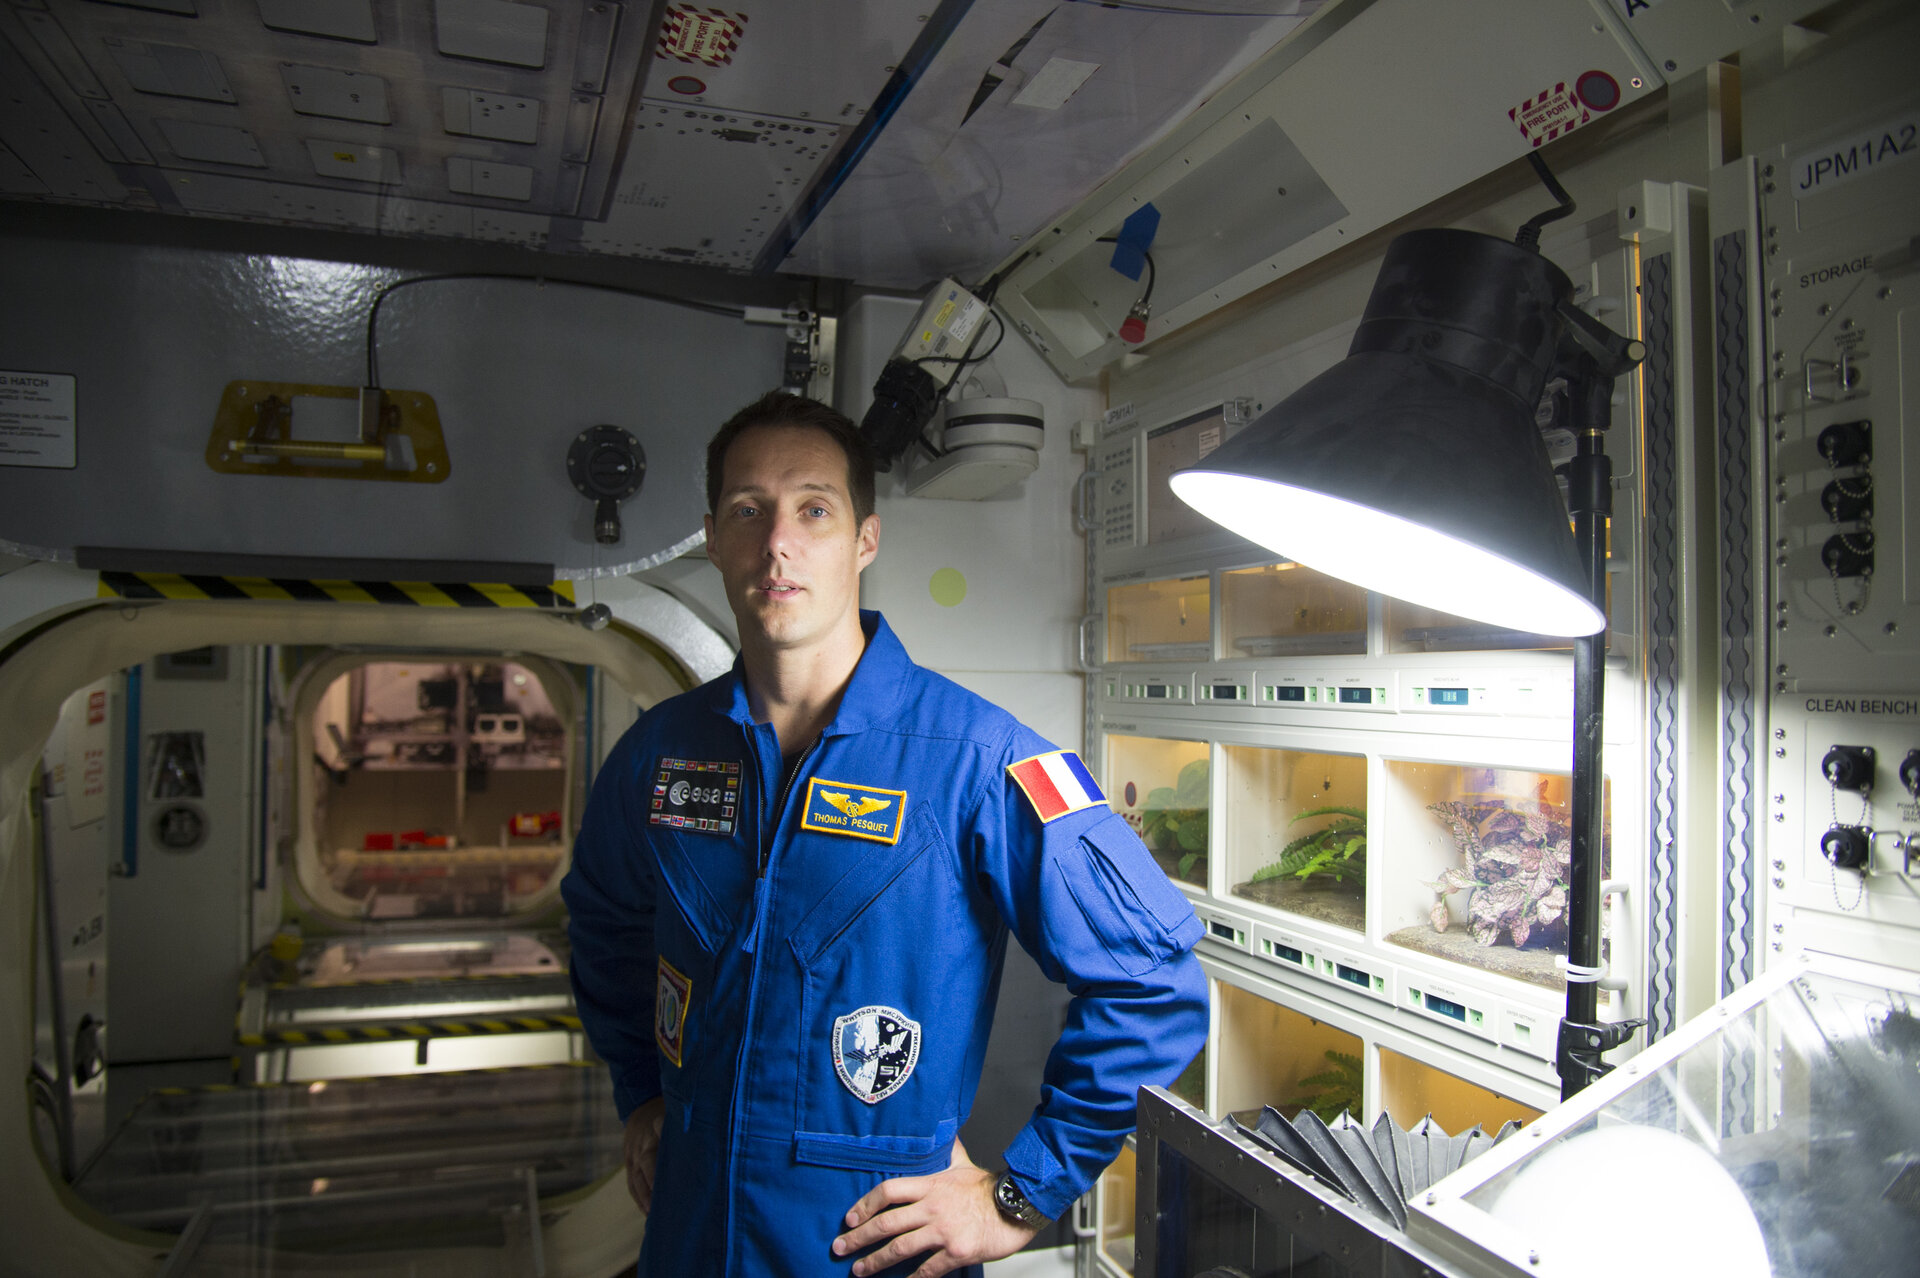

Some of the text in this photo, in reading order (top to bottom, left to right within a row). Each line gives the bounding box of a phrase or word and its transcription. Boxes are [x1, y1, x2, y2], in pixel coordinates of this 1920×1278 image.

[691, 22, 710, 53] FIRE PORT
[1522, 94, 1564, 120] EMERGENCY USE
[1526, 101, 1570, 129] FIRE PORT
[1800, 123, 1917, 189] JPM1A2
[1800, 255, 1873, 288] STORAGE
[11, 377, 49, 387] HATCH
[1805, 699, 1918, 715] CLEAN BENCH
[691, 787, 721, 804] esa
[814, 812, 889, 833] THOMAS PESQUET
[842, 1008, 877, 1024] WHITSON
[880, 1065, 901, 1077] 51
